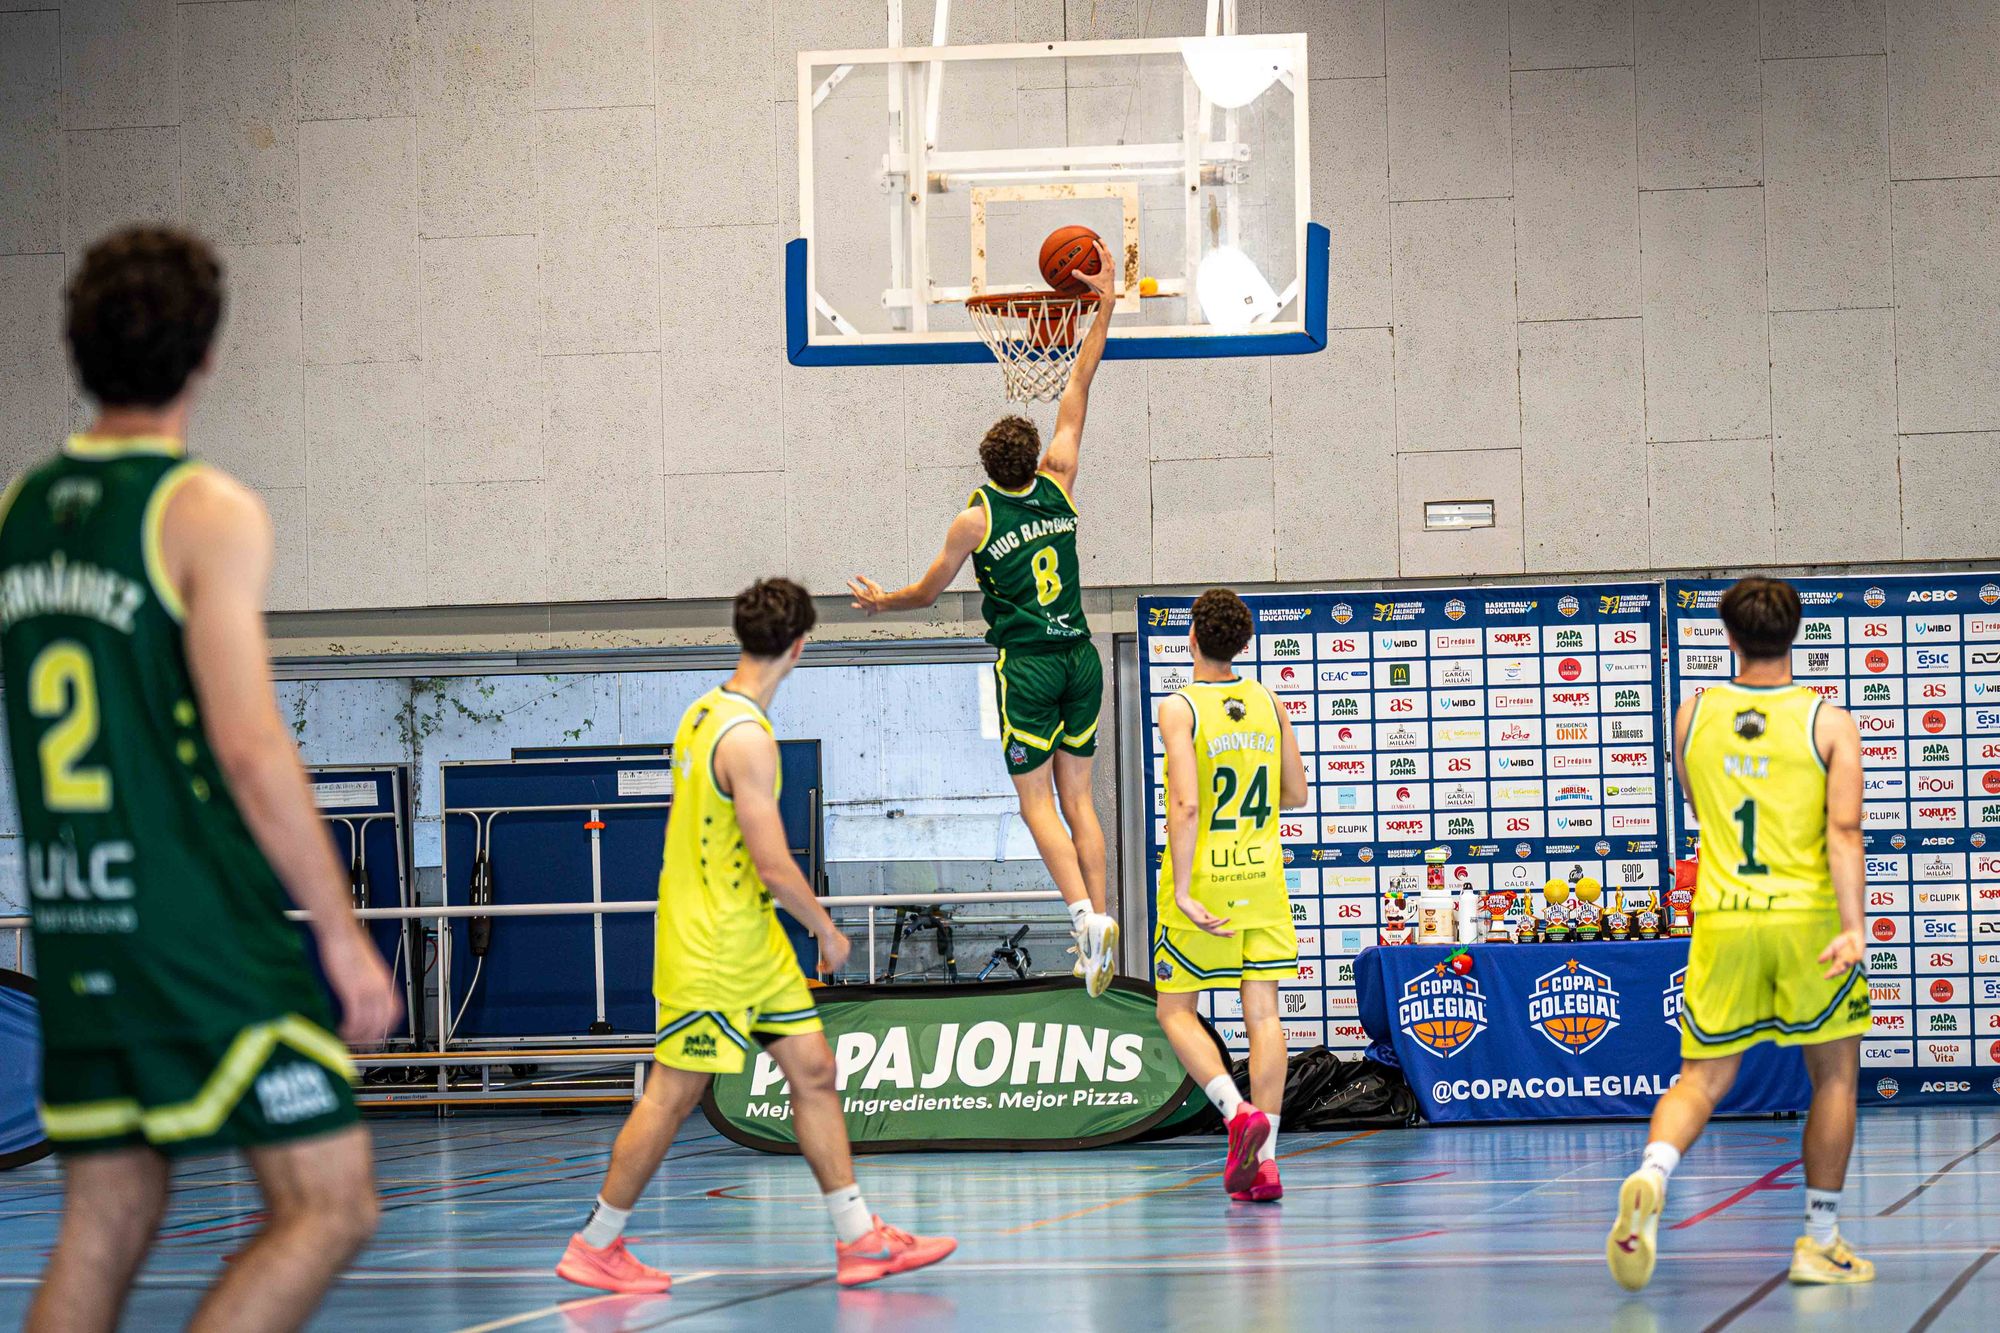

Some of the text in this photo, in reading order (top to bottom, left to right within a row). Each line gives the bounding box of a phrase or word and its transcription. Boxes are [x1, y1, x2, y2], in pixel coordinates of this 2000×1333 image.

[1031, 546, 1062, 606] 8
[1907, 590, 1957, 602] ACBC
[1805, 623, 1831, 632] PAPA
[1864, 623, 1887, 636] as
[1494, 633, 1531, 643] SQRUPS
[1556, 630, 1582, 640] PAPA
[1614, 630, 1636, 643] as
[1274, 639, 1300, 649] PAPA
[1332, 639, 1355, 652] as
[1274, 648, 1300, 656] JOHNS
[1321, 672, 1348, 681] CEAC
[1864, 684, 1890, 693] PAPA
[1923, 684, 1946, 697] as
[1553, 693, 1589, 703] SQRUPS
[1615, 690, 1640, 699] PAPA
[1283, 701, 1307, 710] RUPS
[1332, 698, 1357, 708] PAPA
[1390, 698, 1412, 712] as
[28, 637, 114, 812] 2
[1612, 721, 1622, 730] LES
[1557, 728, 1588, 740] ONIX
[1206, 732, 1275, 758] JORQUERA
[1923, 744, 1949, 754] PAPA
[1860, 747, 1897, 757] SQRUPS
[1390, 758, 1415, 768] PAPA
[1611, 753, 1647, 763] SQRUPS
[1328, 761, 1364, 771] SQRUPS
[1448, 758, 1471, 771] as
[1865, 781, 1884, 789] EAC
[1210, 765, 1271, 832] 24
[1919, 808, 1956, 818] SQRUPS
[1386, 820, 1423, 830] SQRUPS
[1448, 817, 1474, 827] PAPA
[1506, 818, 1529, 831] as
[1280, 824, 1302, 837] as
[1734, 797, 1769, 876] 1
[1922, 837, 1955, 845] ACBC
[1211, 871, 1266, 883] barcelona
[1871, 892, 1894, 905] as
[1290, 904, 1306, 913] APA
[1339, 904, 1361, 917] as
[1871, 952, 1897, 962] PAPA
[1930, 953, 1953, 966] as
[1420, 979, 1464, 996] COPA
[1552, 976, 1595, 992] COPA
[1869, 988, 1901, 1000] ONIX
[1399, 997, 1488, 1026] COLEGIAL
[1529, 994, 1620, 1022] COLEGIAL
[1872, 1016, 1904, 1026] QRUPS
[1930, 1013, 1956, 1023] PAPA
[1865, 1049, 1892, 1058] CEAC
[1929, 1044, 1959, 1054] Quota
[750, 1020, 1143, 1096] PPA JOHNS
[1934, 1053, 1954, 1062] Vita
[1920, 1081, 1970, 1092] ACBC
[746, 1087, 1139, 1118] Mej Ingredientes. Mejor Pizza.
